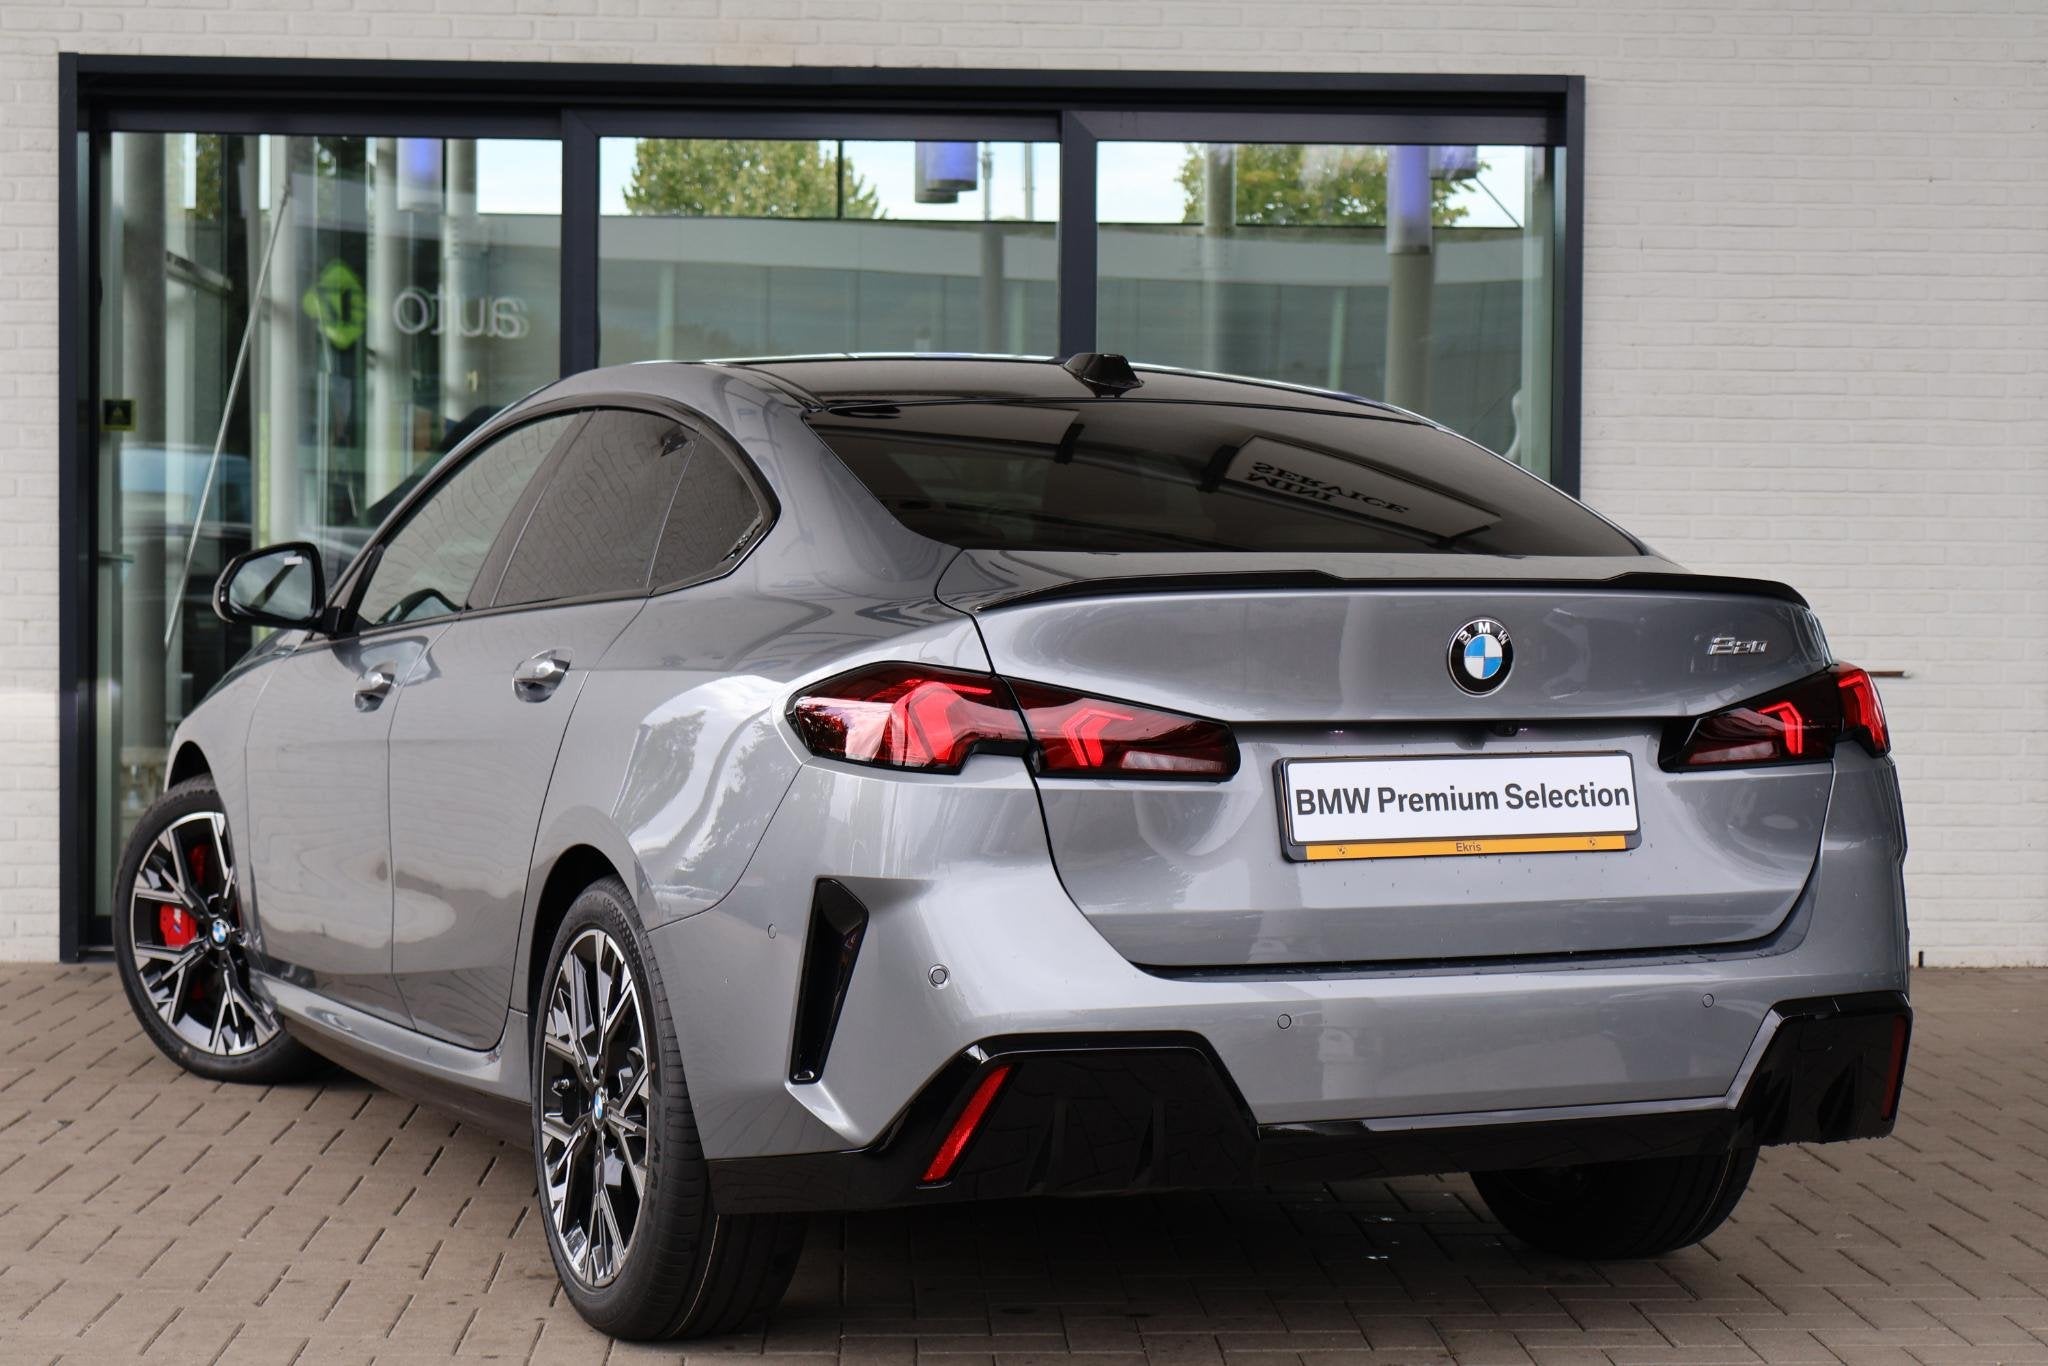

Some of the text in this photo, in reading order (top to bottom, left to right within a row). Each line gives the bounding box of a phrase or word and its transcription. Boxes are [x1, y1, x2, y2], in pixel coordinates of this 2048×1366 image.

[1457, 621, 1510, 646] BMW
[1296, 782, 1630, 815] BMW Premium Selection
[1456, 842, 1482, 852] Ekris
